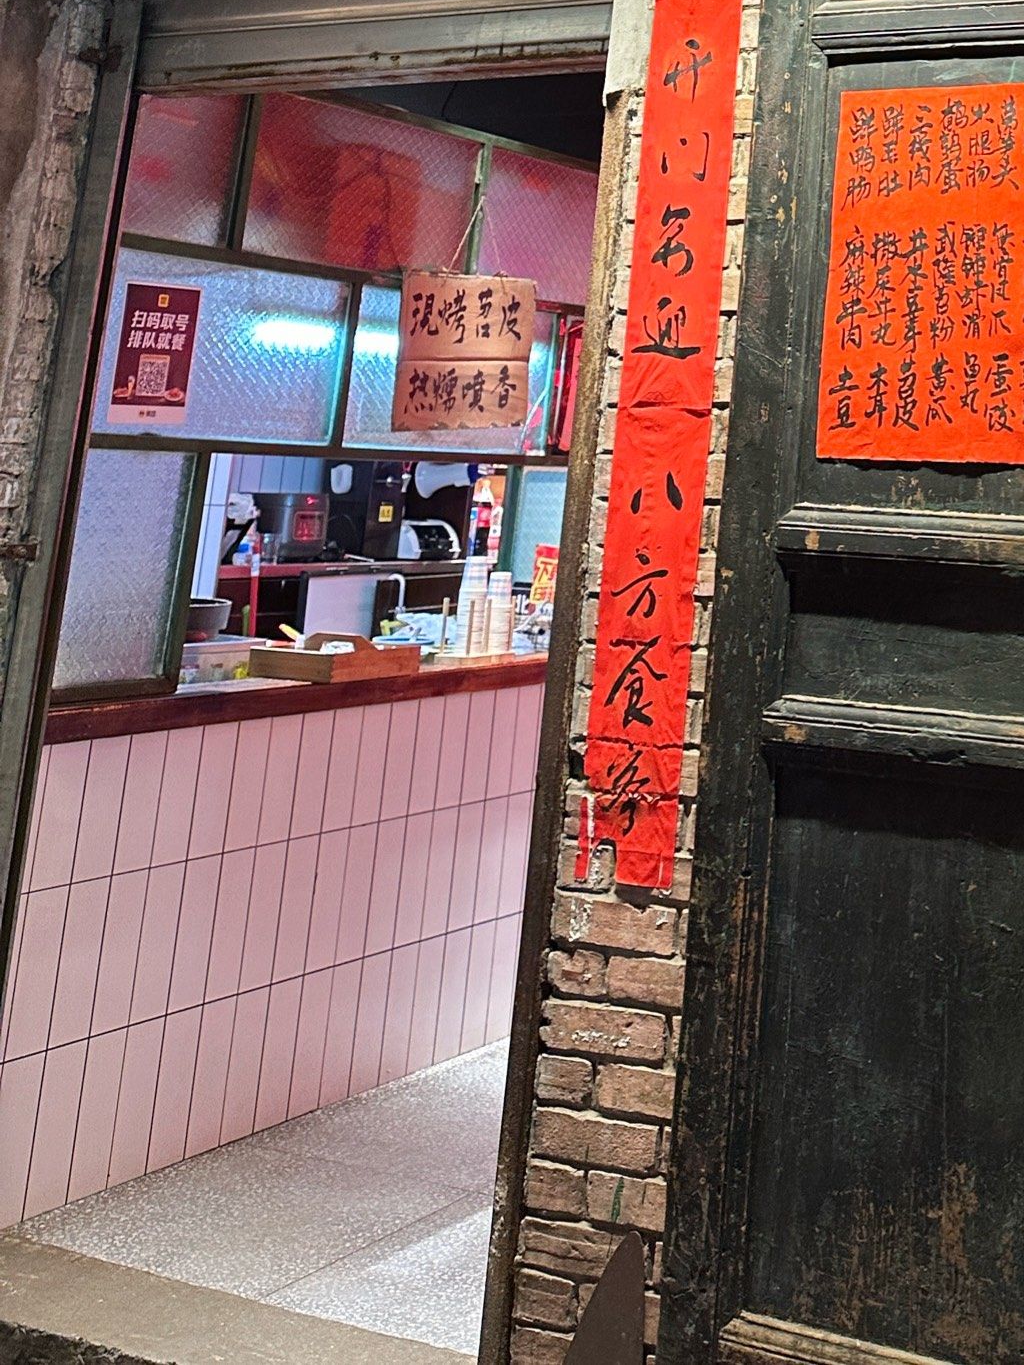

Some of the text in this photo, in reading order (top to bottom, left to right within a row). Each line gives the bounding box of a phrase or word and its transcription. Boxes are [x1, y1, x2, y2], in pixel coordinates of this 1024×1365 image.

[130, 310, 190, 332] 扫码取号
[126, 330, 187, 351] 排队就餐
